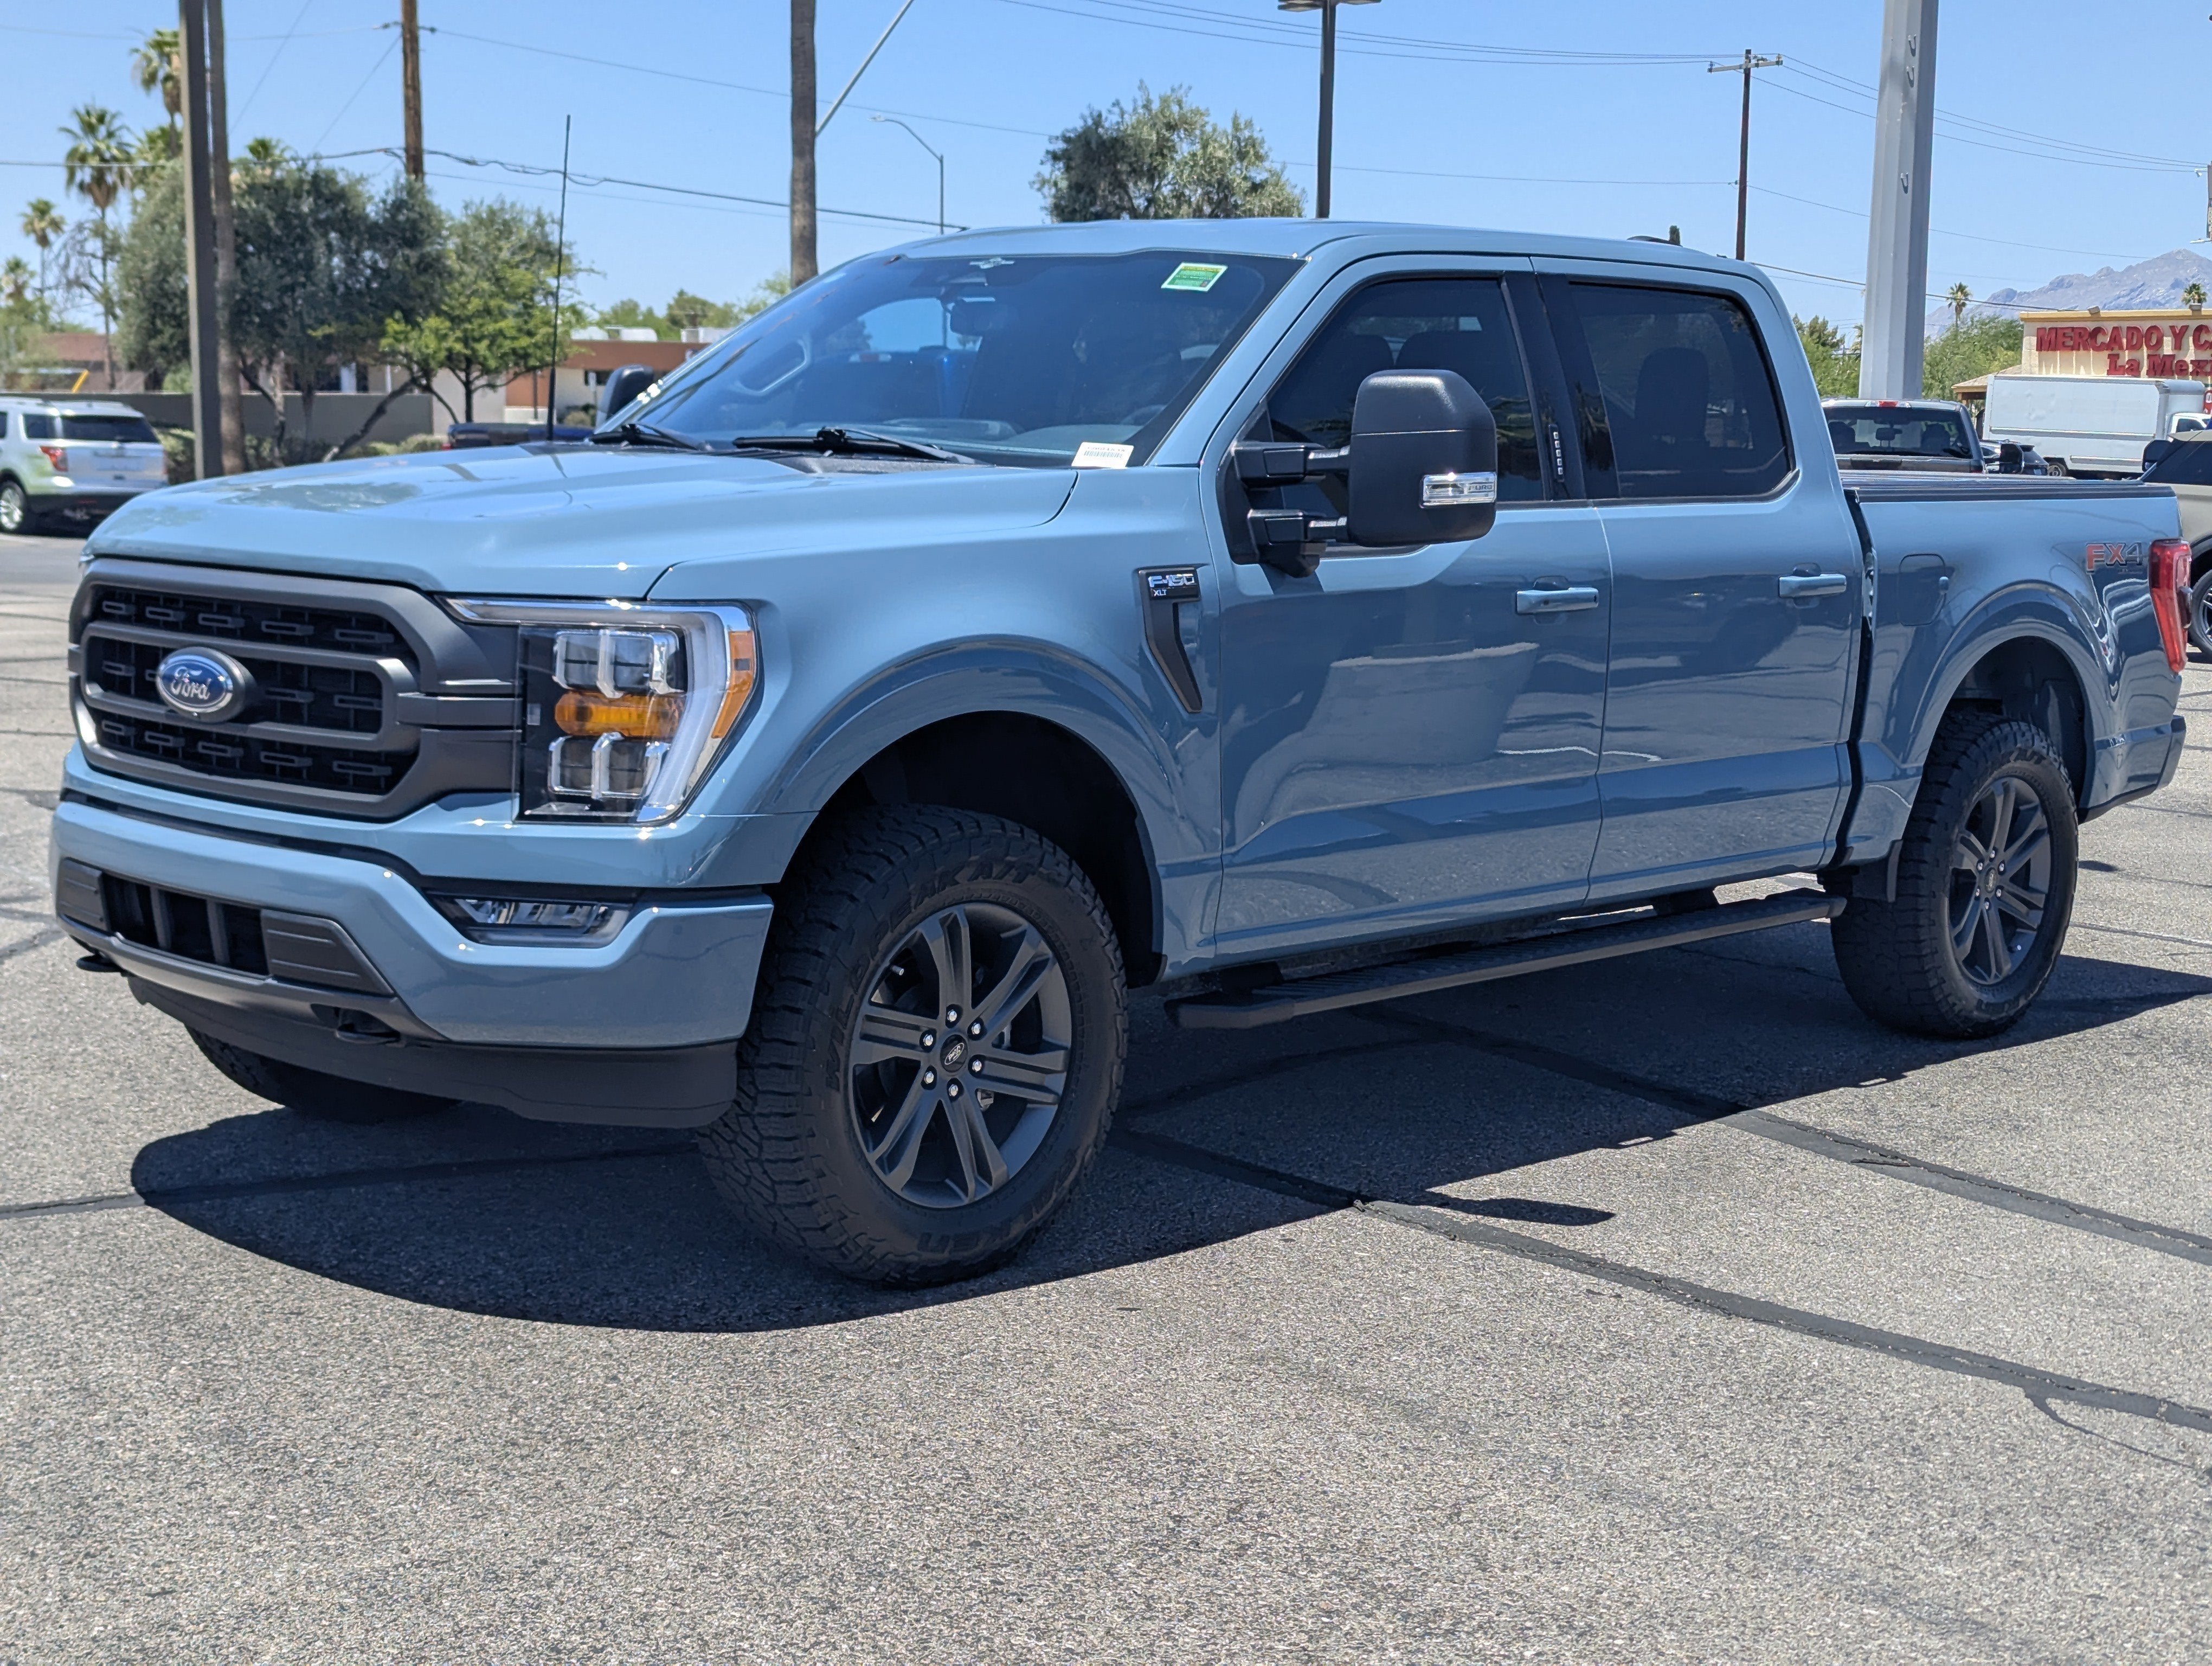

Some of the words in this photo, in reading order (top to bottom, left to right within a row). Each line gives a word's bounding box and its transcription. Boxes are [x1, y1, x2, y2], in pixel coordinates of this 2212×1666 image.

[2036, 325, 2164, 351] MERCADO
[2169, 325, 2190, 351] Y
[2192, 324, 2212, 350] C
[2107, 354, 2141, 376] La
[2086, 542, 2142, 572] FX4
[1148, 573, 1195, 588] F-150
[170, 667, 211, 700] Ford
[948, 1045, 961, 1061] Ford
